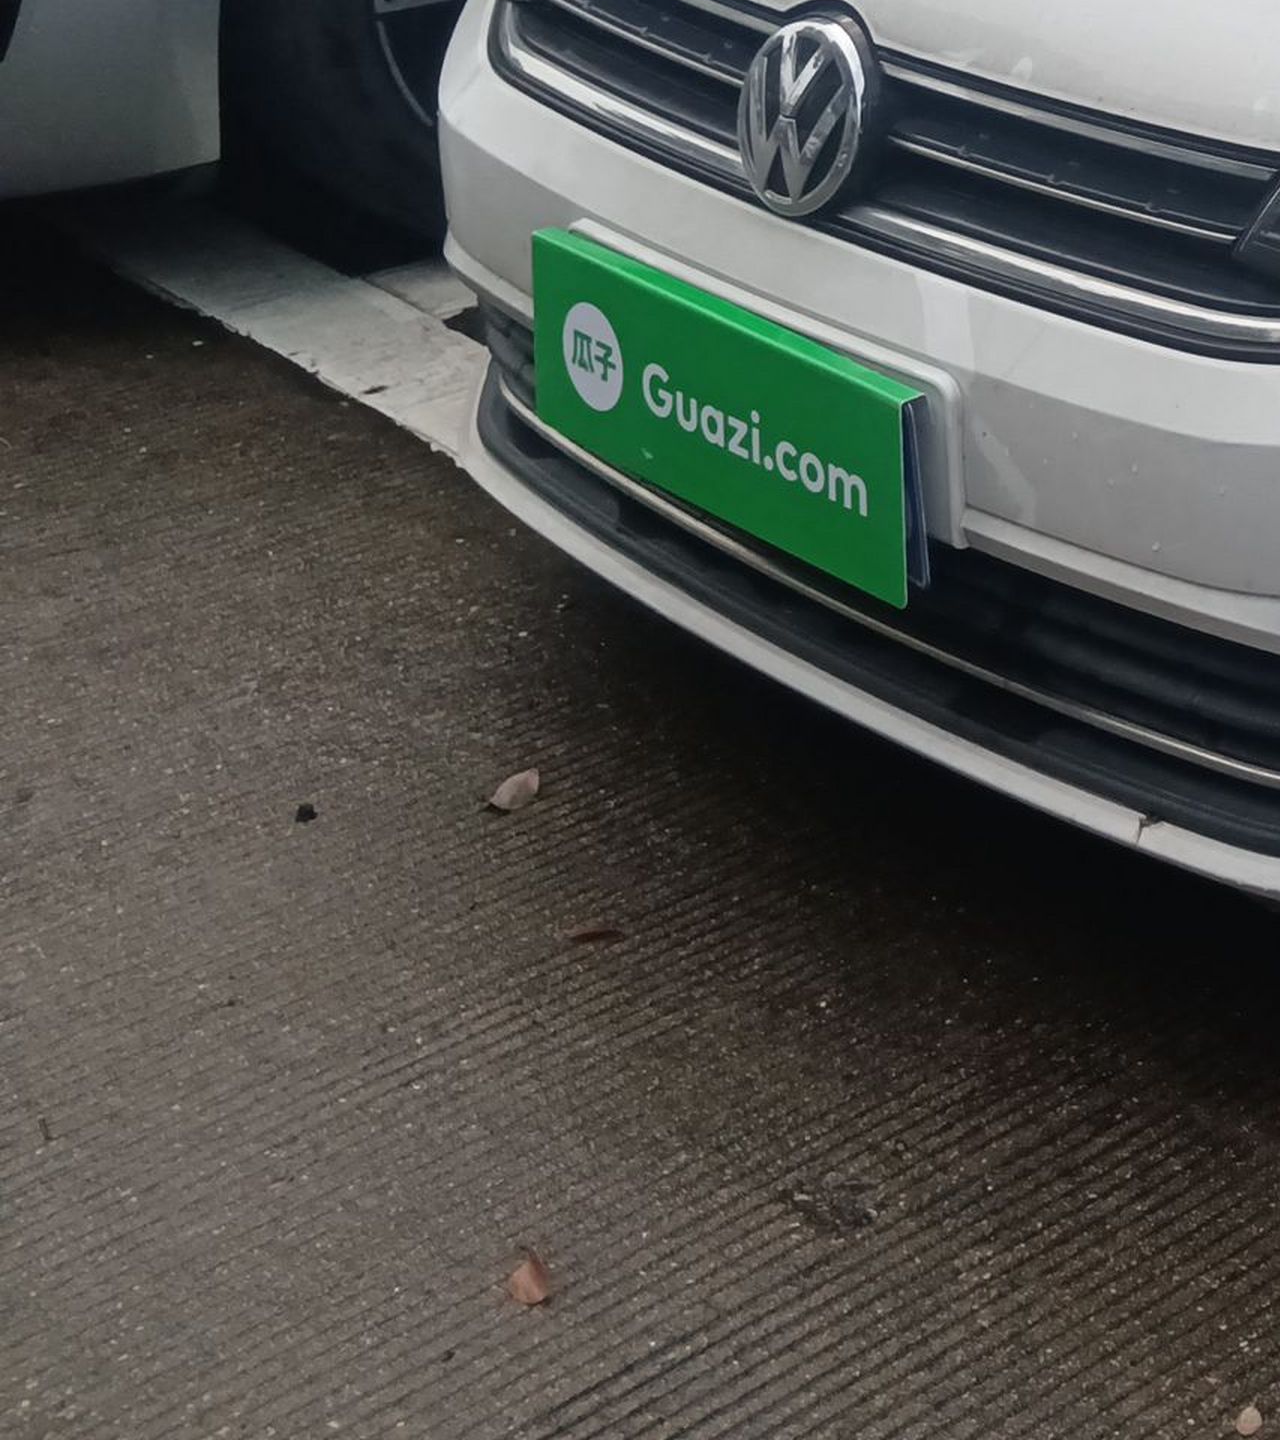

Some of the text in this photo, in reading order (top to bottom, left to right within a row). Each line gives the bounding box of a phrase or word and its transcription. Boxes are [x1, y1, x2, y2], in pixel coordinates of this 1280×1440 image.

[738, 20, 864, 215] VW
[572, 329, 617, 382] 瓜子
[642, 363, 868, 517] Guazi.com
